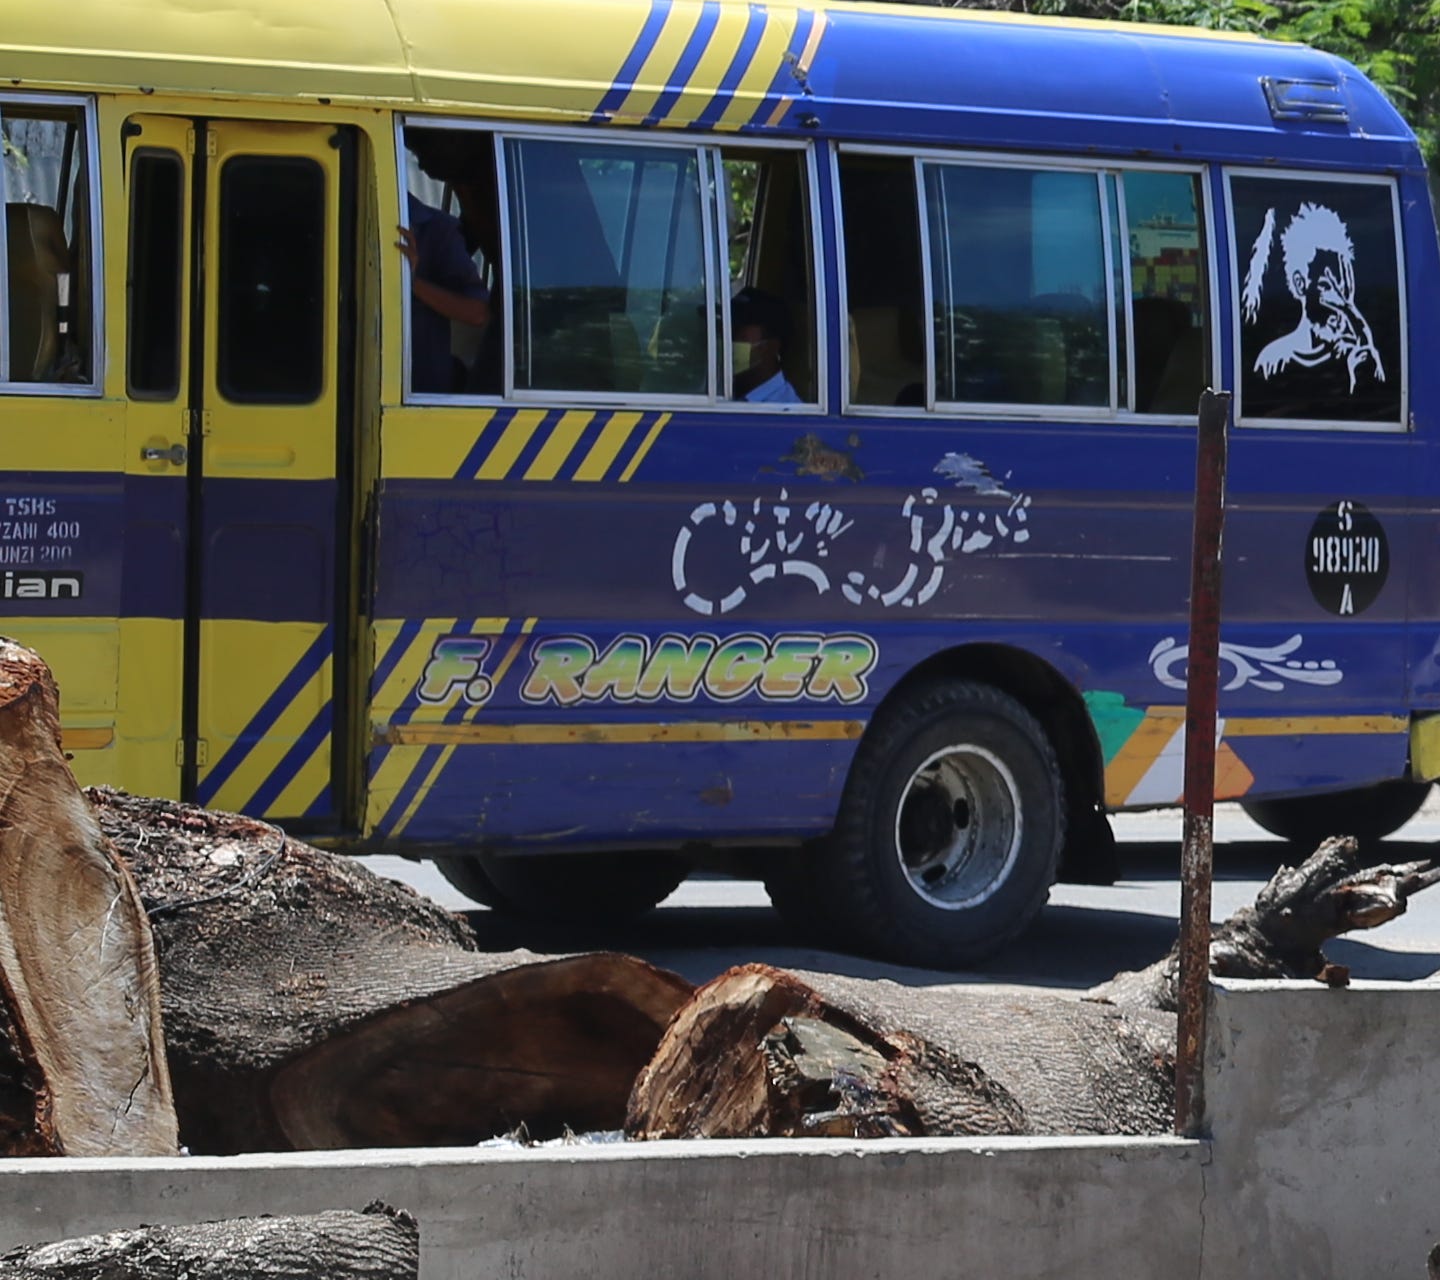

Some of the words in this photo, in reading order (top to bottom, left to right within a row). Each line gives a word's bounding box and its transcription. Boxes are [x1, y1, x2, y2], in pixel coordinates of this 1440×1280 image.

[0, 522, 37, 539] ZANI
[47, 521, 80, 539] 400
[1338, 500, 1352, 531] S
[40, 546, 72, 563] 200
[1313, 536, 1379, 573] 98920
[4, 571, 80, 598] ian
[1340, 583, 1353, 614] A
[417, 635, 494, 705] F.
[519, 631, 879, 706] RANGER
